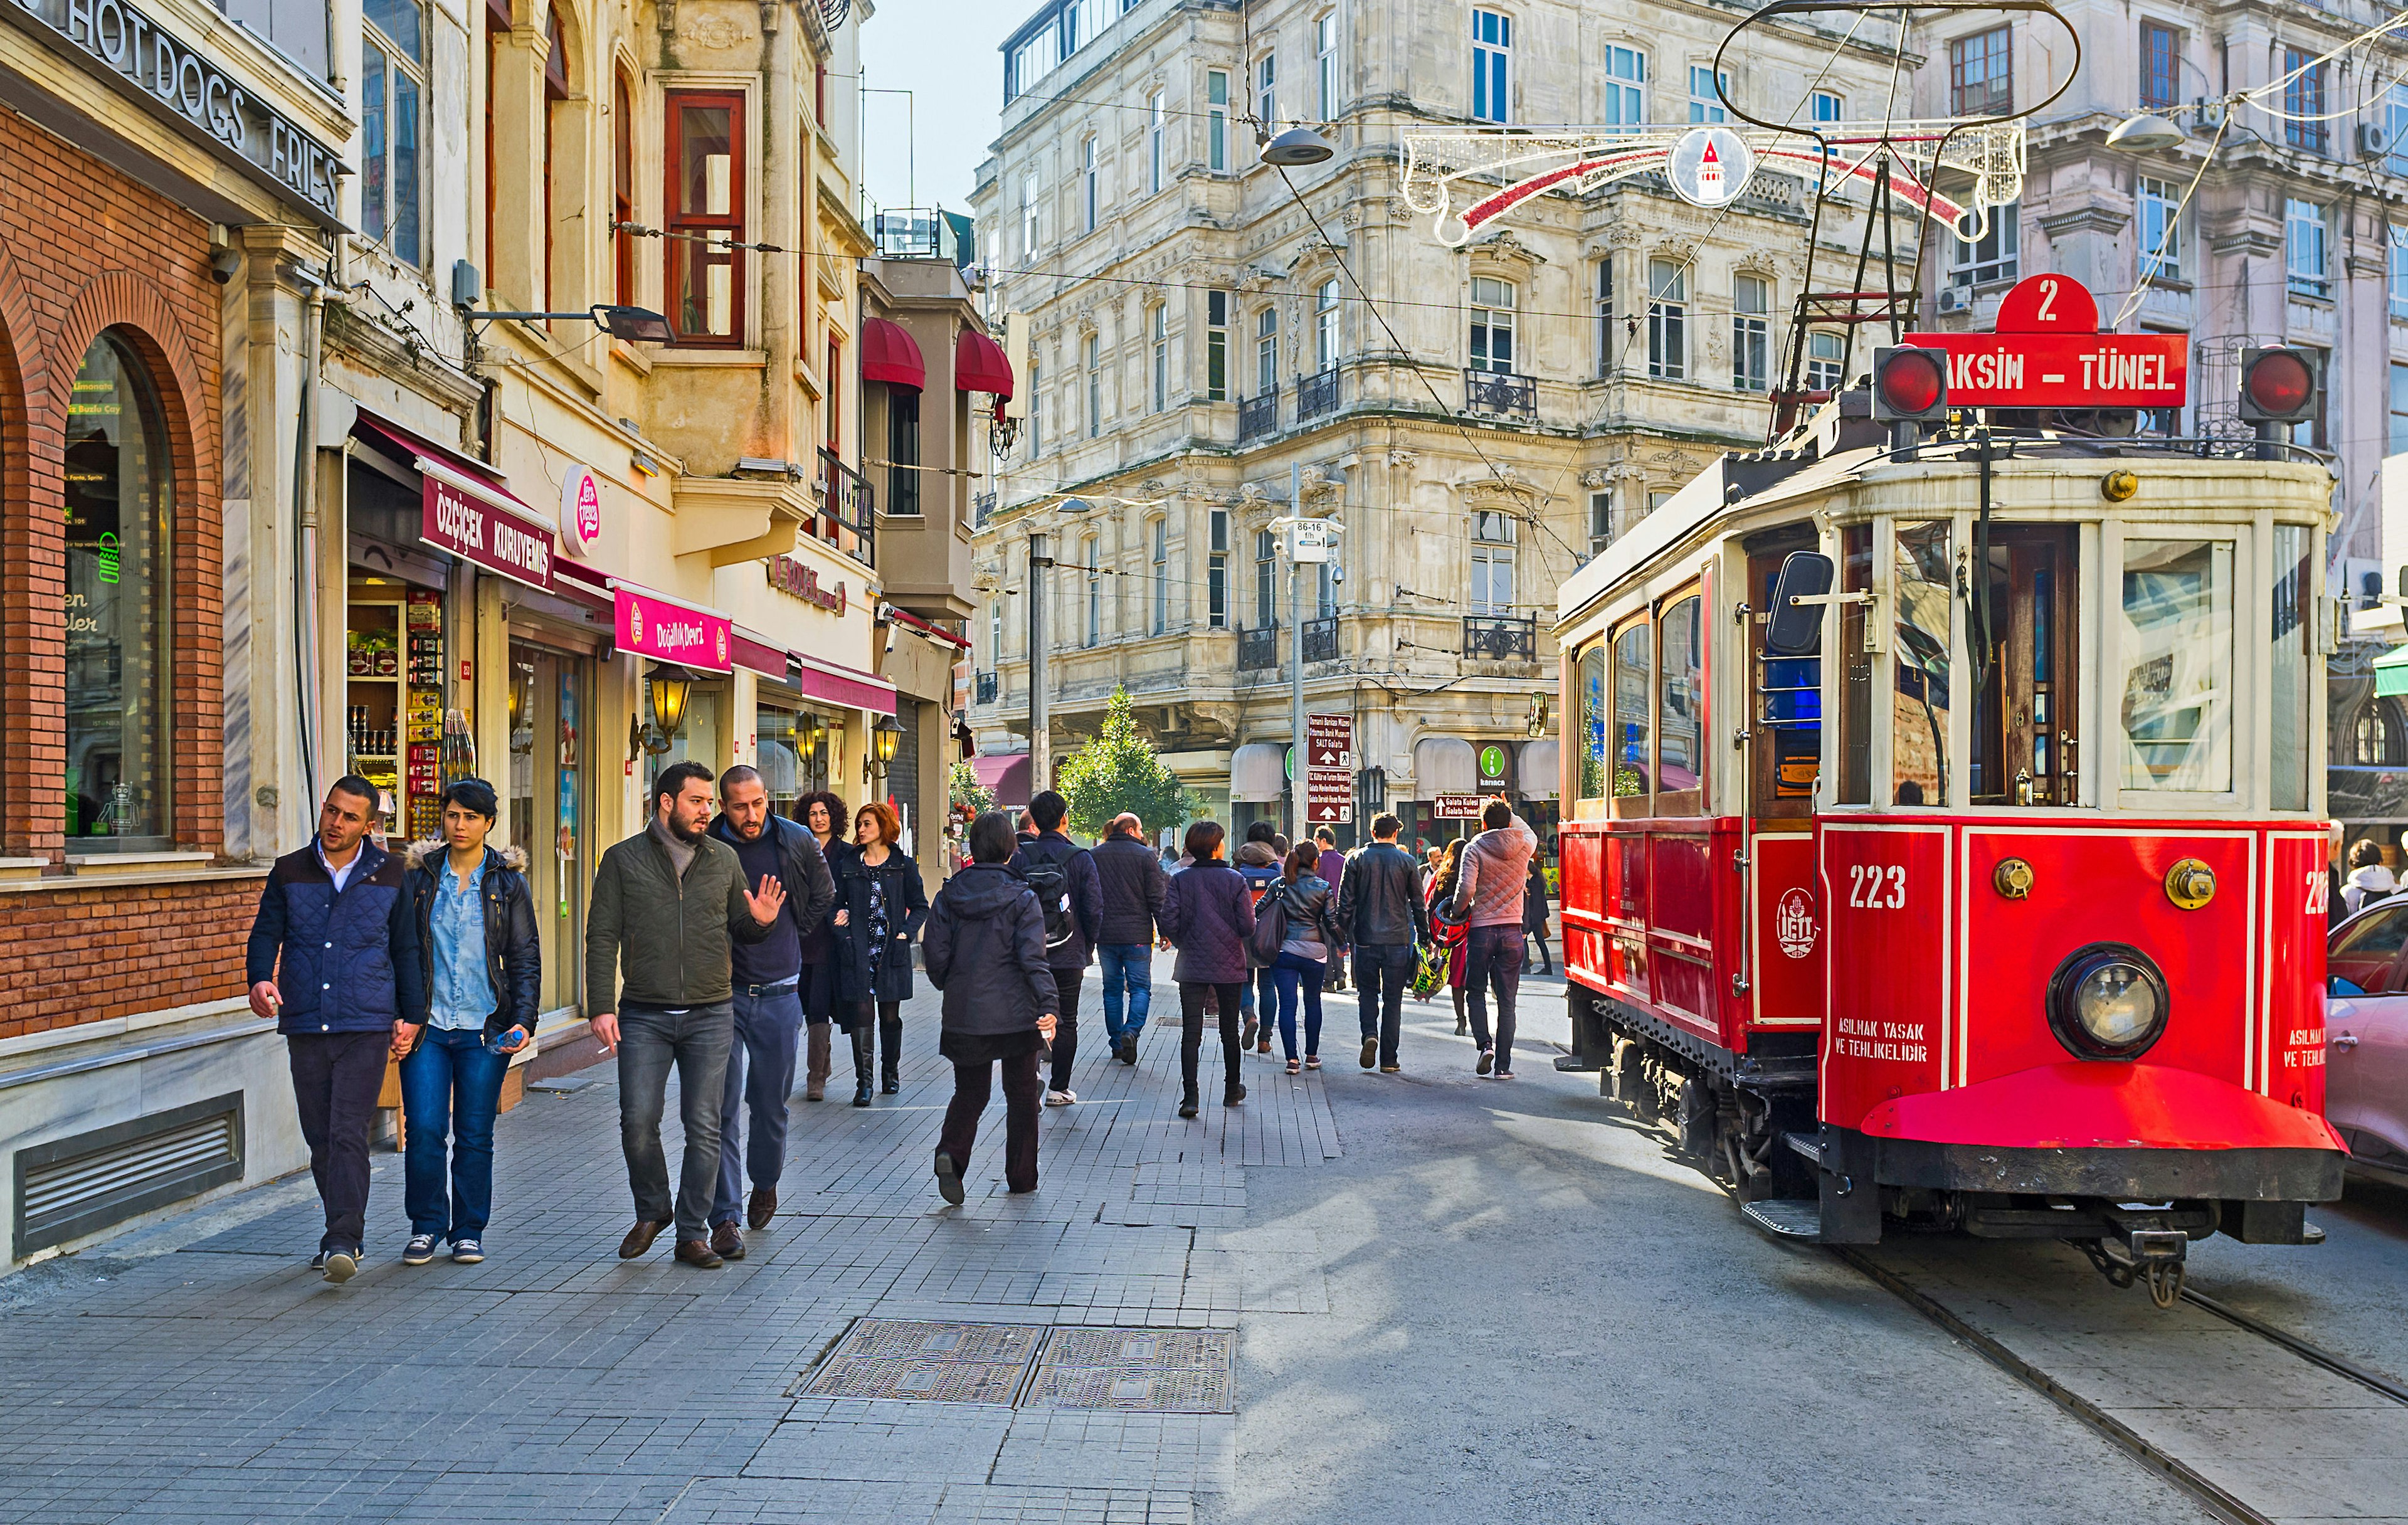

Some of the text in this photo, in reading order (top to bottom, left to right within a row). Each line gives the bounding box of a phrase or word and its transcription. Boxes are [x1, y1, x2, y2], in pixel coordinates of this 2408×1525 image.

[65, 0, 337, 215] HOT DOGS FRIES
[2038, 280, 2058, 320] 2
[2079, 347, 2176, 389] TÜNEL
[73, 382, 114, 390] Limonata
[78, 405, 102, 413] Buzlu
[104, 405, 121, 414] Çay
[436, 482, 483, 556] ÖZÇİÇEK
[1297, 522, 1321, 531] 86-16
[493, 520, 549, 586] KURUYEMİŞ
[657, 622, 685, 653] Doğallık
[684, 620, 704, 647] Devri
[1316, 738, 1343, 749] SALT Galata
[1325, 728, 1334, 737] Bank
[1334, 729, 1349, 738] Museum
[1445, 797, 1479, 806] Galata Kulesi
[1445, 806, 1480, 816] (Galata Tower)
[1851, 865, 1906, 909] 223
[1839, 1018, 1924, 1041] ASILMAK YASAK
[1835, 1037, 1927, 1062] VE TEHLİKELİDİR
[2284, 1051, 2298, 1067] VE
